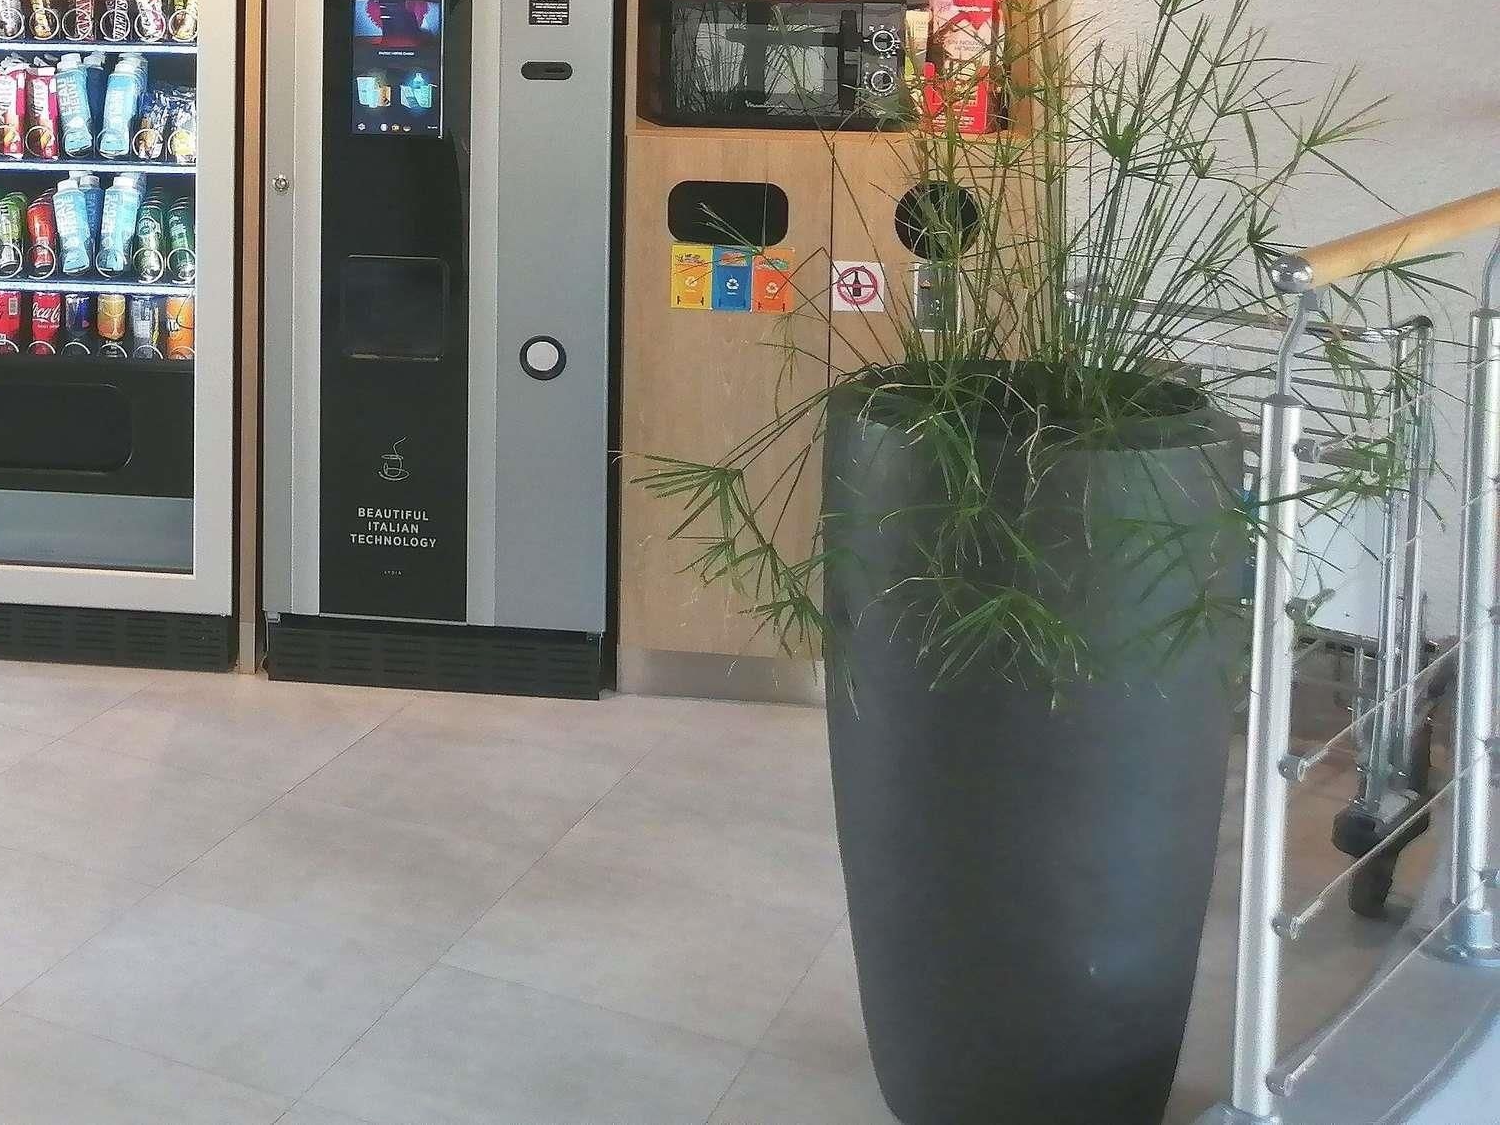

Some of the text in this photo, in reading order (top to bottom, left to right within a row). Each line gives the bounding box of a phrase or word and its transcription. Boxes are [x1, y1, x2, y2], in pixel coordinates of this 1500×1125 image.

[358, 507, 429, 521] BEAUTIFUL
[368, 521, 419, 534] ITALIAN
[350, 533, 436, 548] TECHNOLOGY
